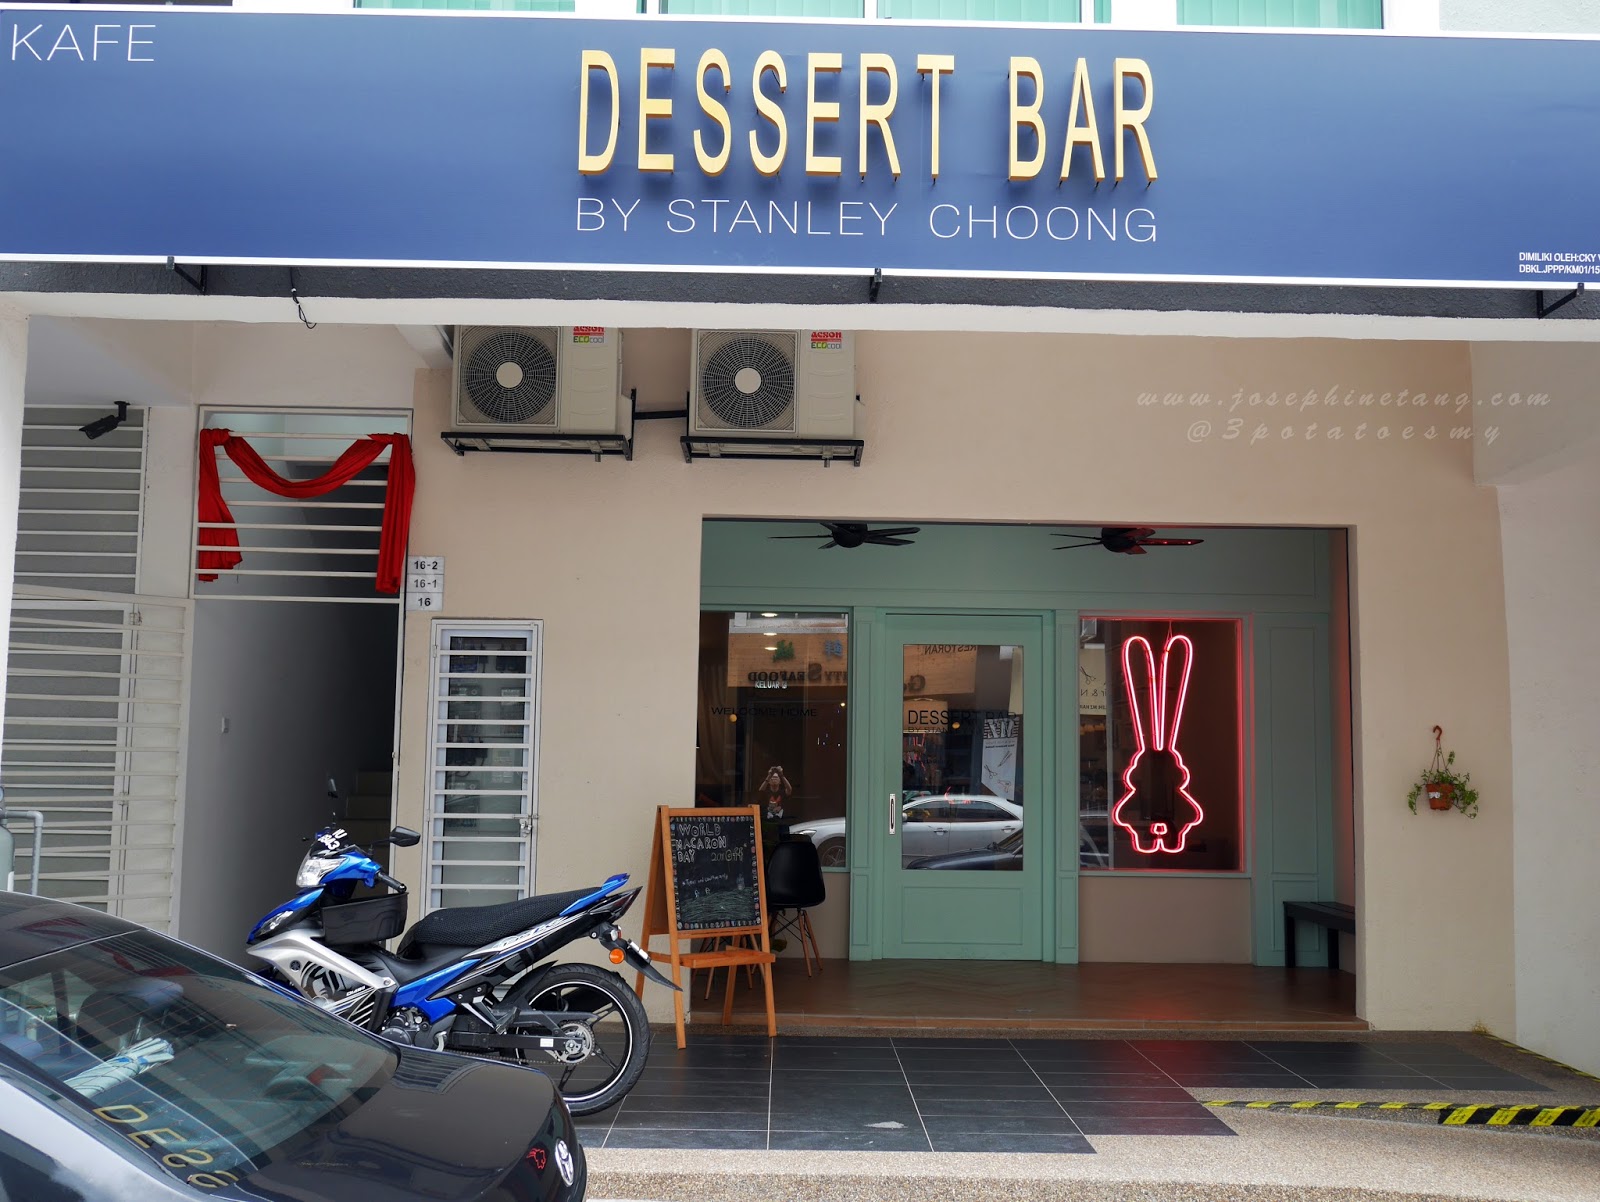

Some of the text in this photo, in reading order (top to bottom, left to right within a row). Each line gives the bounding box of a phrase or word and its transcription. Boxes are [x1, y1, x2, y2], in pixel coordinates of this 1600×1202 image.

[10, 23, 157, 63] KAFE
[577, 47, 1159, 182] DESSERT BAR
[576, 197, 1158, 242] BY STANLEY CHOONG
[1519, 252, 1552, 262] DIMILIKI
[414, 560, 438, 570] 16-2
[414, 579, 437, 588] 16-1
[418, 597, 431, 607] 16
[754, 680, 780, 689] KELUAR
[711, 706, 817, 717] WELCOME HOME
[908, 710, 981, 725] DESSERT
[679, 823, 721, 836] WORLD
[676, 836, 727, 850] MACARON
[678, 848, 695, 862] DAY
